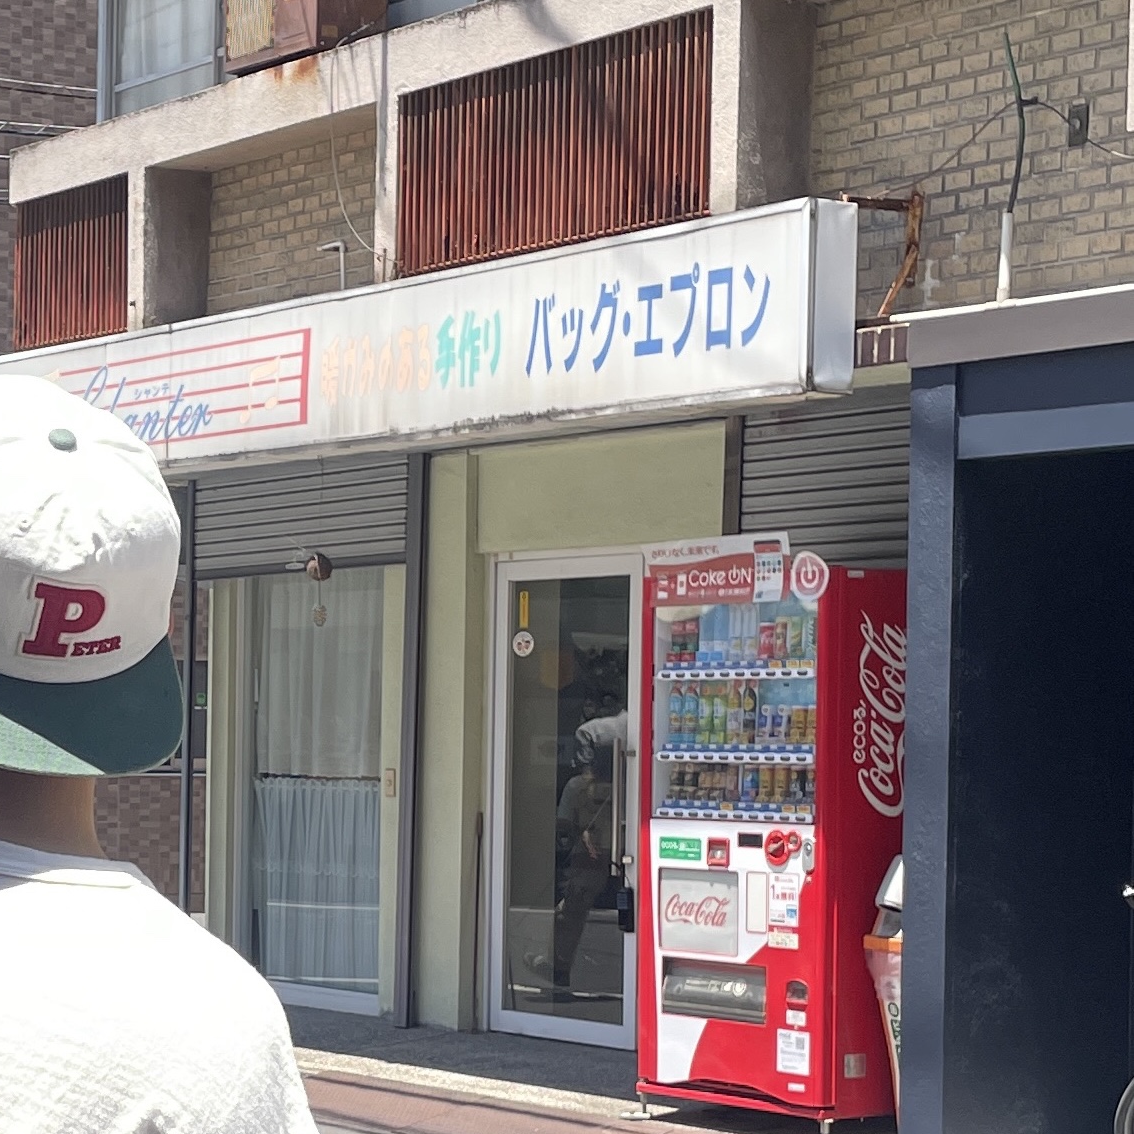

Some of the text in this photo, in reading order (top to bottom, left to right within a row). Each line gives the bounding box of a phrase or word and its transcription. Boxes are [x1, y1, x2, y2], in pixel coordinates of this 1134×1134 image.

[525, 261, 771, 378] バッグ・エプロン
[688, 564, 753, 589] Coke ON
